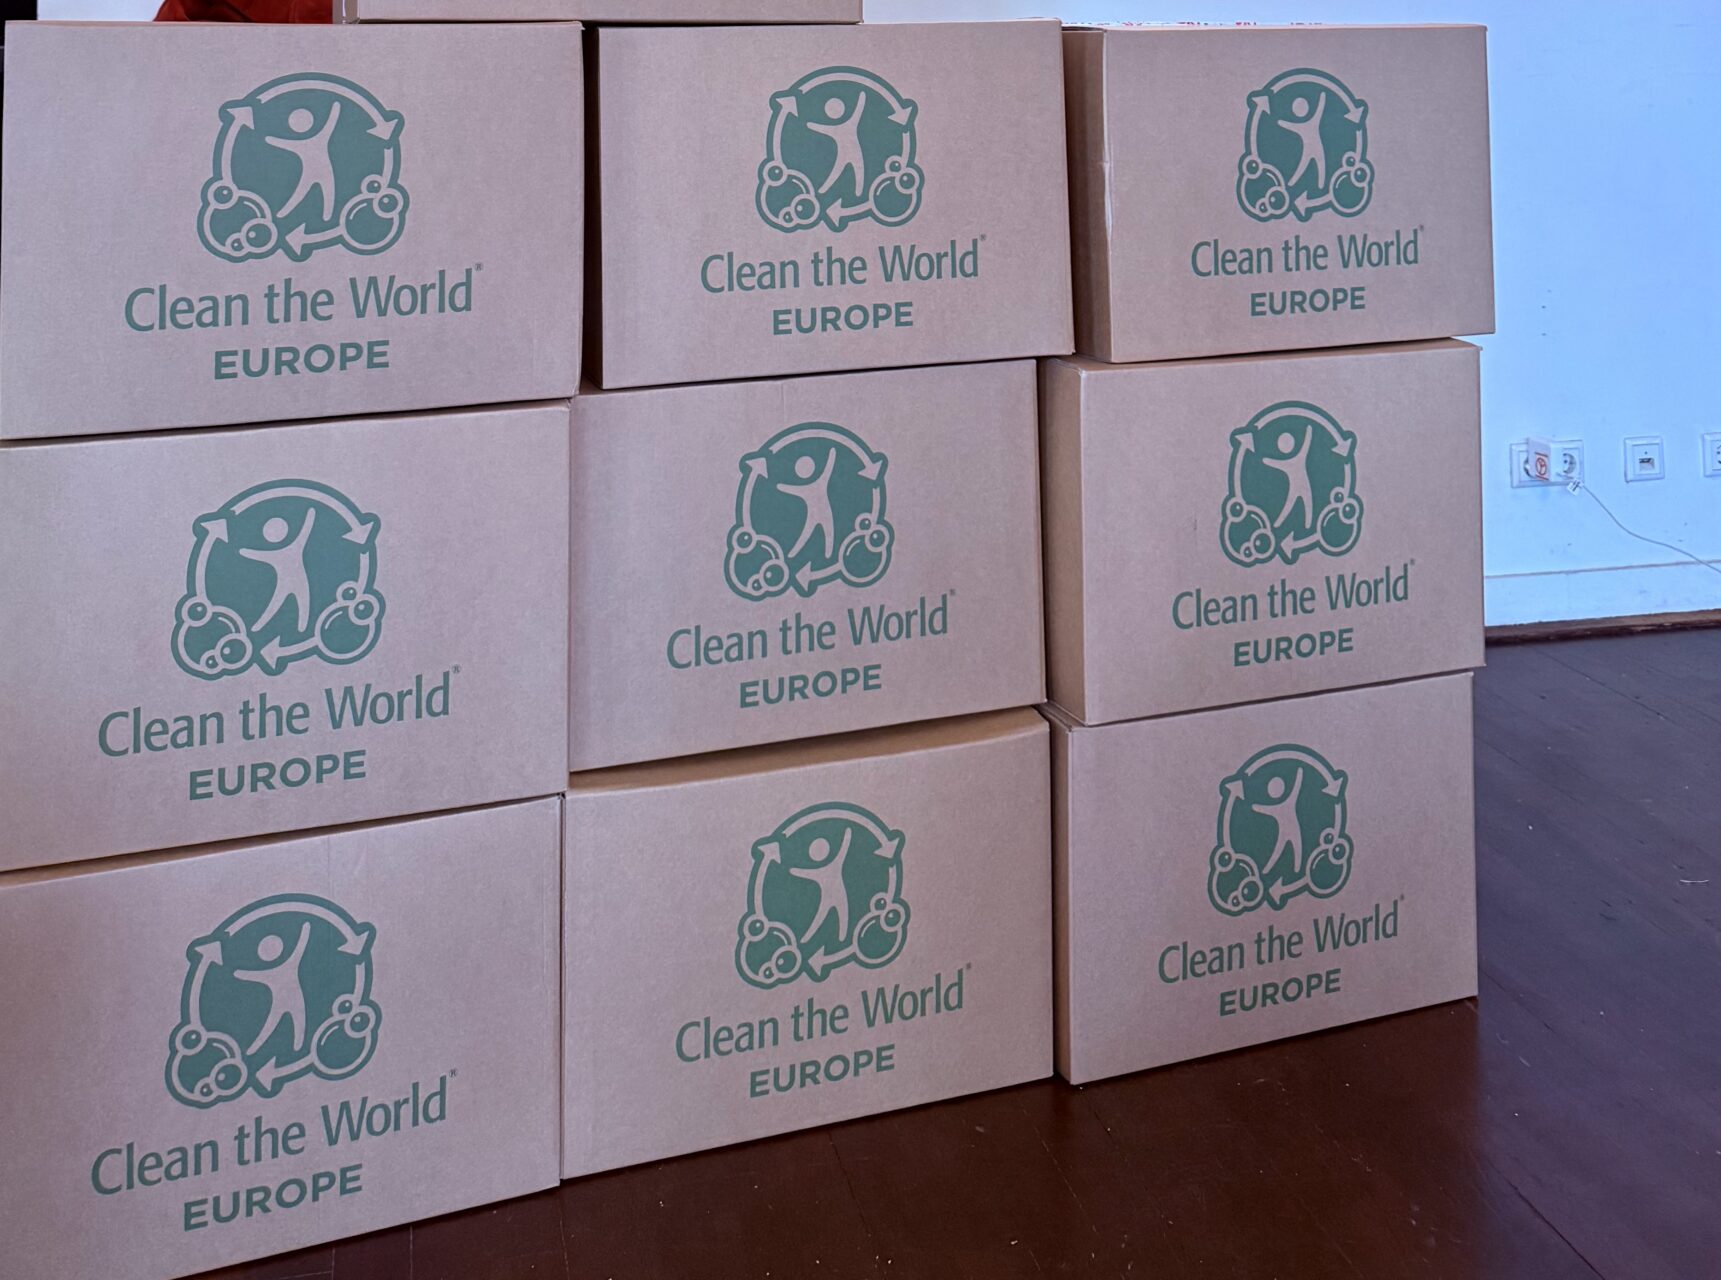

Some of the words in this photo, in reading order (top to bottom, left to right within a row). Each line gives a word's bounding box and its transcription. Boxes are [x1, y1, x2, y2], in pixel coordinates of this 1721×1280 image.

[699, 252, 800, 295] Clean
[811, 244, 868, 288] the
[1190, 239, 1273, 278] Clean
[1281, 234, 1329, 273] the
[124, 283, 249, 333] Clean
[265, 276, 334, 326] the
[769, 302, 912, 336] EUROPE
[1249, 287, 1367, 318] EUROPE
[213, 339, 390, 382] EUROPE
[1171, 588, 1258, 631] Clean
[1267, 578, 1316, 619] the
[665, 622, 768, 670] Clean
[779, 611, 836, 656] the
[1232, 627, 1353, 667] EUROPE
[738, 665, 880, 709] EUROPE
[98, 707, 224, 757] Clean
[239, 693, 311, 743] the
[188, 750, 366, 801] EUROPE
[1157, 941, 1245, 985] Clean
[1254, 925, 1303, 966] the
[1217, 968, 1341, 1017] EUROPE
[674, 1014, 779, 1064] Clean
[790, 997, 848, 1044] the
[748, 1043, 895, 1098] EUROPE
[91, 1139, 219, 1196] Clean
[236, 1116, 306, 1167] the
[182, 1164, 362, 1232] EUROPE
